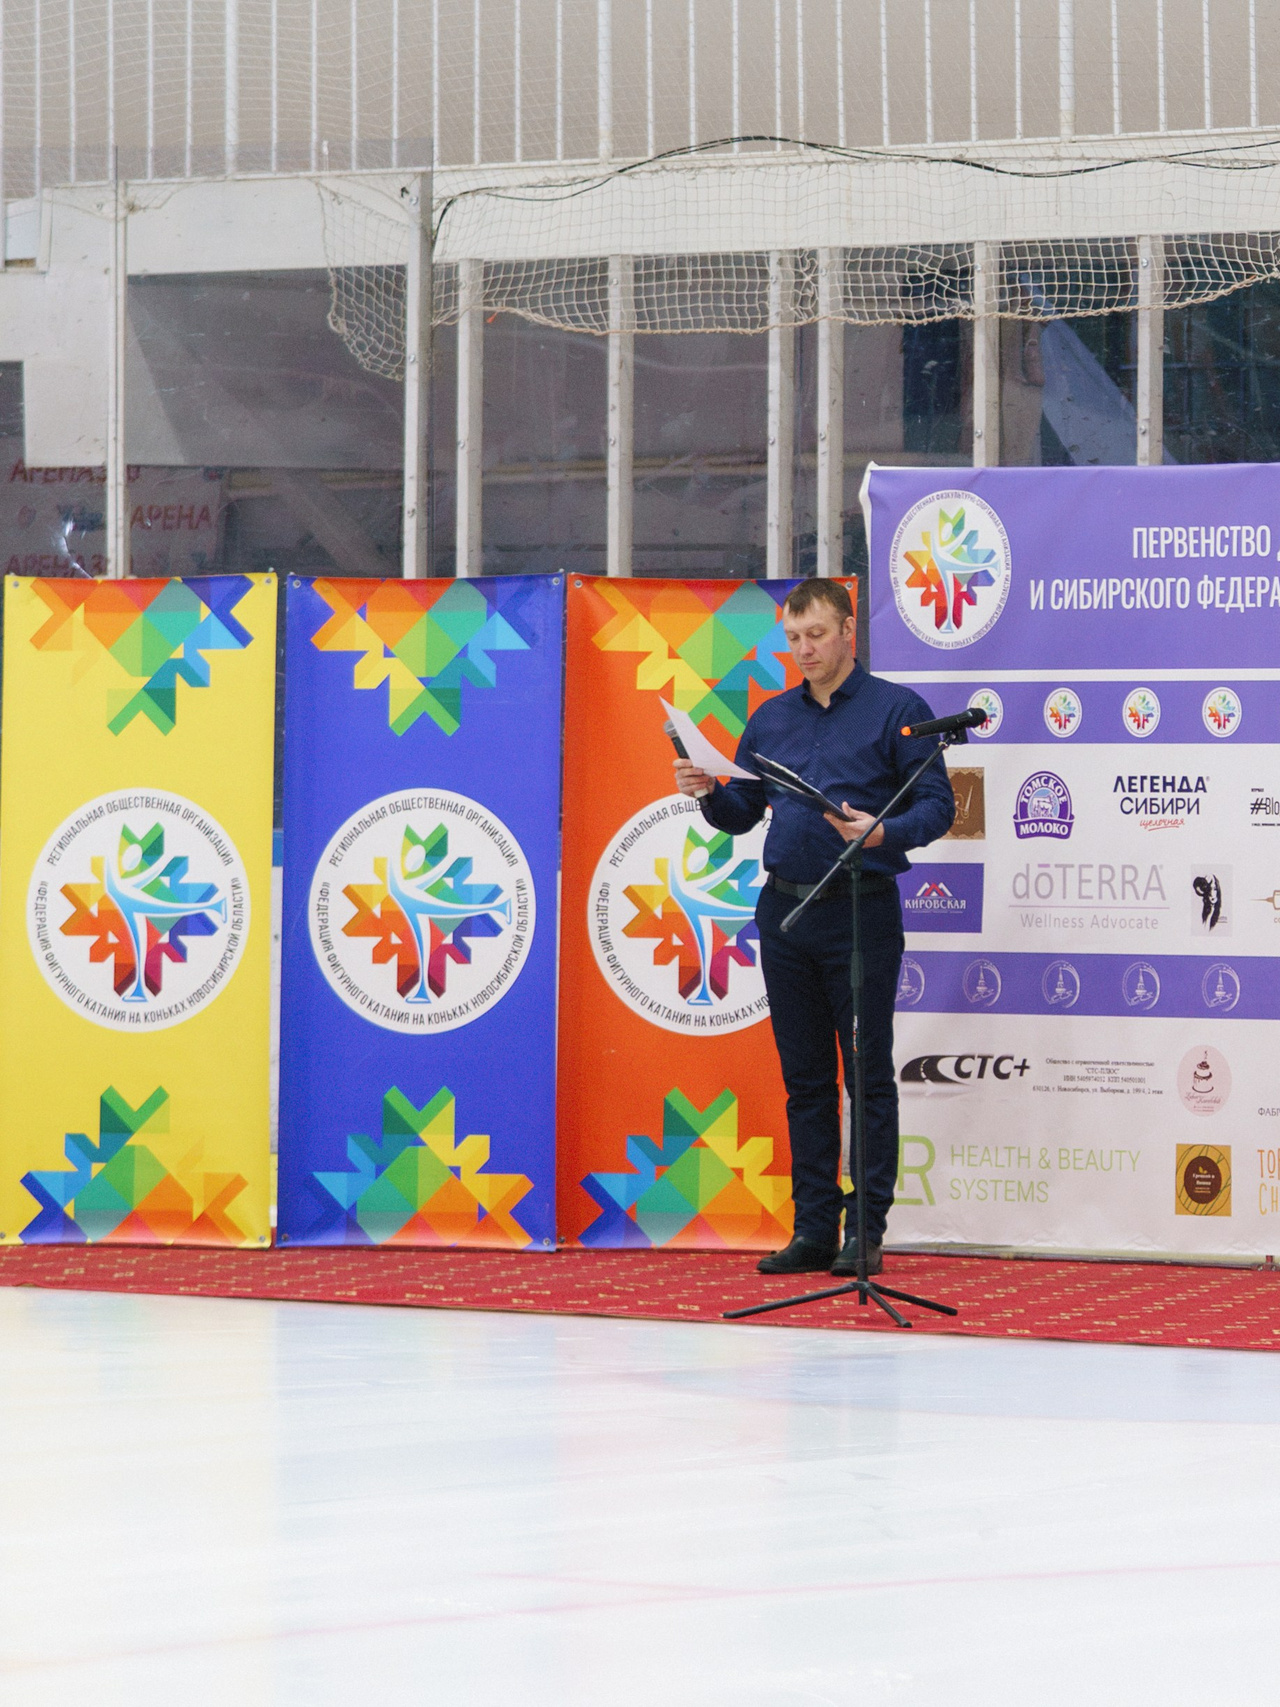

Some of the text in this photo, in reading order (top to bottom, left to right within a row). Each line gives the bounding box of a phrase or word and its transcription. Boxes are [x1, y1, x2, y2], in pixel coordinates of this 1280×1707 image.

[1132, 524, 1272, 559] ПЕРВЕНСТВО
[1029, 579, 1045, 611] И
[1050, 576, 1191, 611] СИБИРСКОГО
[1020, 776, 1066, 804] ТОМСКОЕ
[1113, 775, 1207, 793] ЛЕГЕНДА
[1119, 796, 1200, 815] СИБИРИ
[47, 796, 235, 867] РЕГИОНАЛЬНАЯ ОБЩЕСТВЕННАЯ ОРГАНИЗАЦИЯ
[329, 796, 519, 868] РЕГИОНАЛЬНАЯ ОБЩЕСТВЕННАЯ ОРГАНИЗАЦИЯ
[609, 807, 670, 868] РЕГИОНАЛЬНАЯ
[1019, 822, 1069, 836] МОЛОКО
[904, 898, 967, 910] КИРОВСКАЯ
[1020, 913, 1159, 930] Wellness Advocate
[44, 951, 86, 1004] ФИГУРНОГО
[83, 997, 127, 1023] КАТАНИЯ
[128, 1013, 142, 1024] НА
[144, 1000, 189, 1024] КОНЬКАХ
[188, 933, 242, 1008] НОВОСИБИРСКОЙ
[326, 952, 368, 1005] ФИГУРНОГО
[366, 998, 410, 1025] КАТАНИЯ
[412, 1013, 426, 1026] НА
[427, 1002, 472, 1026] КОНЬКАХ
[471, 935, 526, 1008] НОВОСИБИРСКОЙ
[606, 954, 649, 1006] ФИГУРНОГО
[647, 999, 692, 1025] КАТАНИЯ
[693, 1014, 708, 1027] НА
[709, 1003, 756, 1027] КОНЬКАХ
[950, 1144, 1141, 1172] HEALTH & BEAUTY
[950, 1178, 1049, 1203] SYSTEMS
